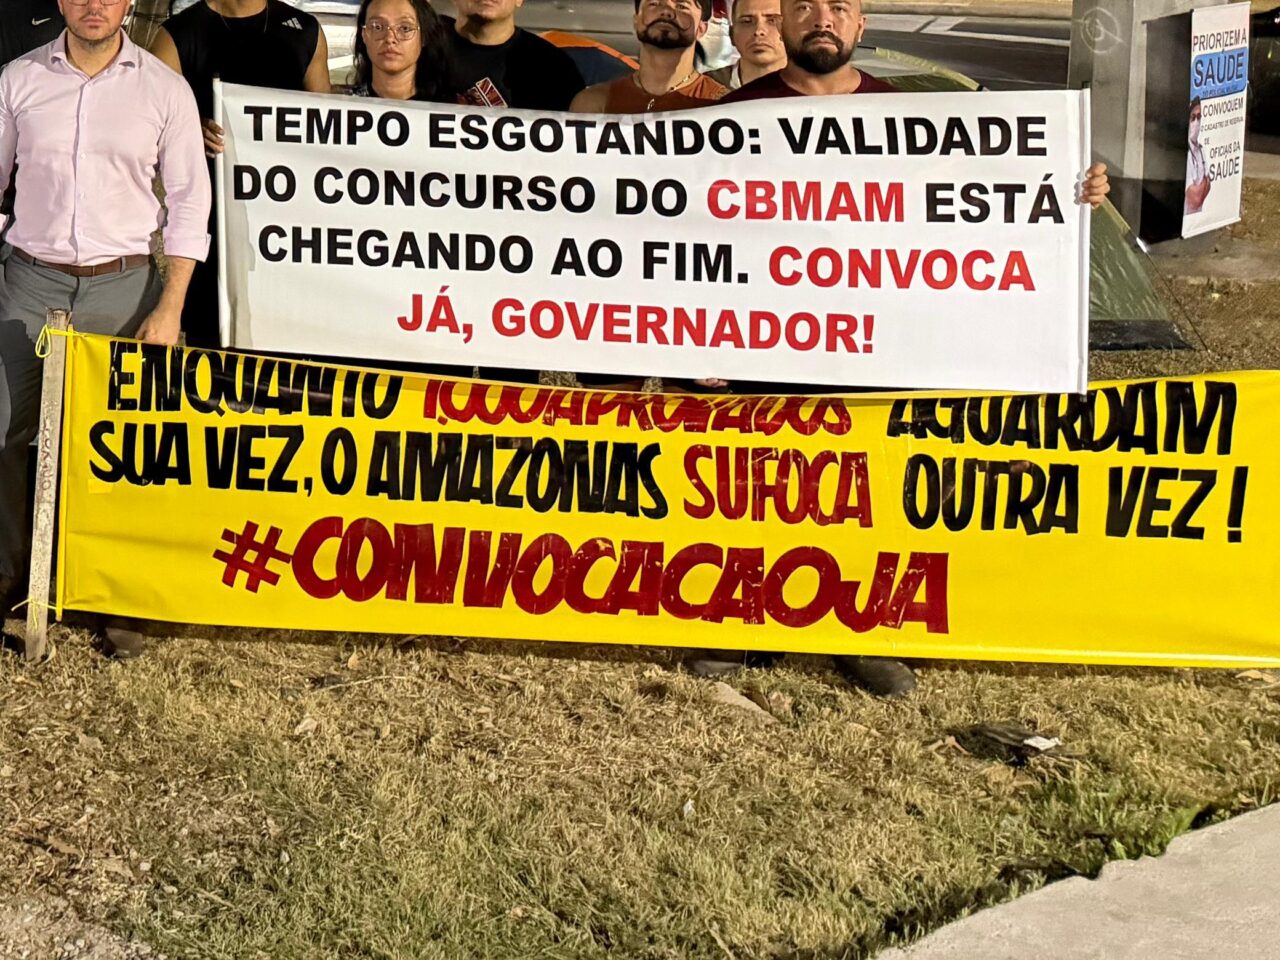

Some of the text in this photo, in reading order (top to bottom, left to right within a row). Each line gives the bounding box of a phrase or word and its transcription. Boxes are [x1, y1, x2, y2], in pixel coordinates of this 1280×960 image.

[1193, 48, 1245, 88] SAÚDE
[243, 105, 1048, 157] TEMPO ESGOTANDO: VALIDADE
[233, 164, 1066, 225] DO CONCURSO DO CBMAM ESTÁ
[258, 225, 1037, 292] CHEGANDO AO FIM. CONVOCA
[397, 285, 875, 355] JÁ, GOVERNADOR!
[107, 341, 403, 419] ENQUANTO
[88, 421, 192, 487] SUA
[204, 424, 314, 499] VEZ,
[320, 425, 359, 496] O
[366, 430, 670, 520] AMAZONAS
[683, 444, 874, 528] SUFOCA
[902, 452, 1080, 536] OUTRA
[211, 515, 950, 635] #CONVOCACAOJA
